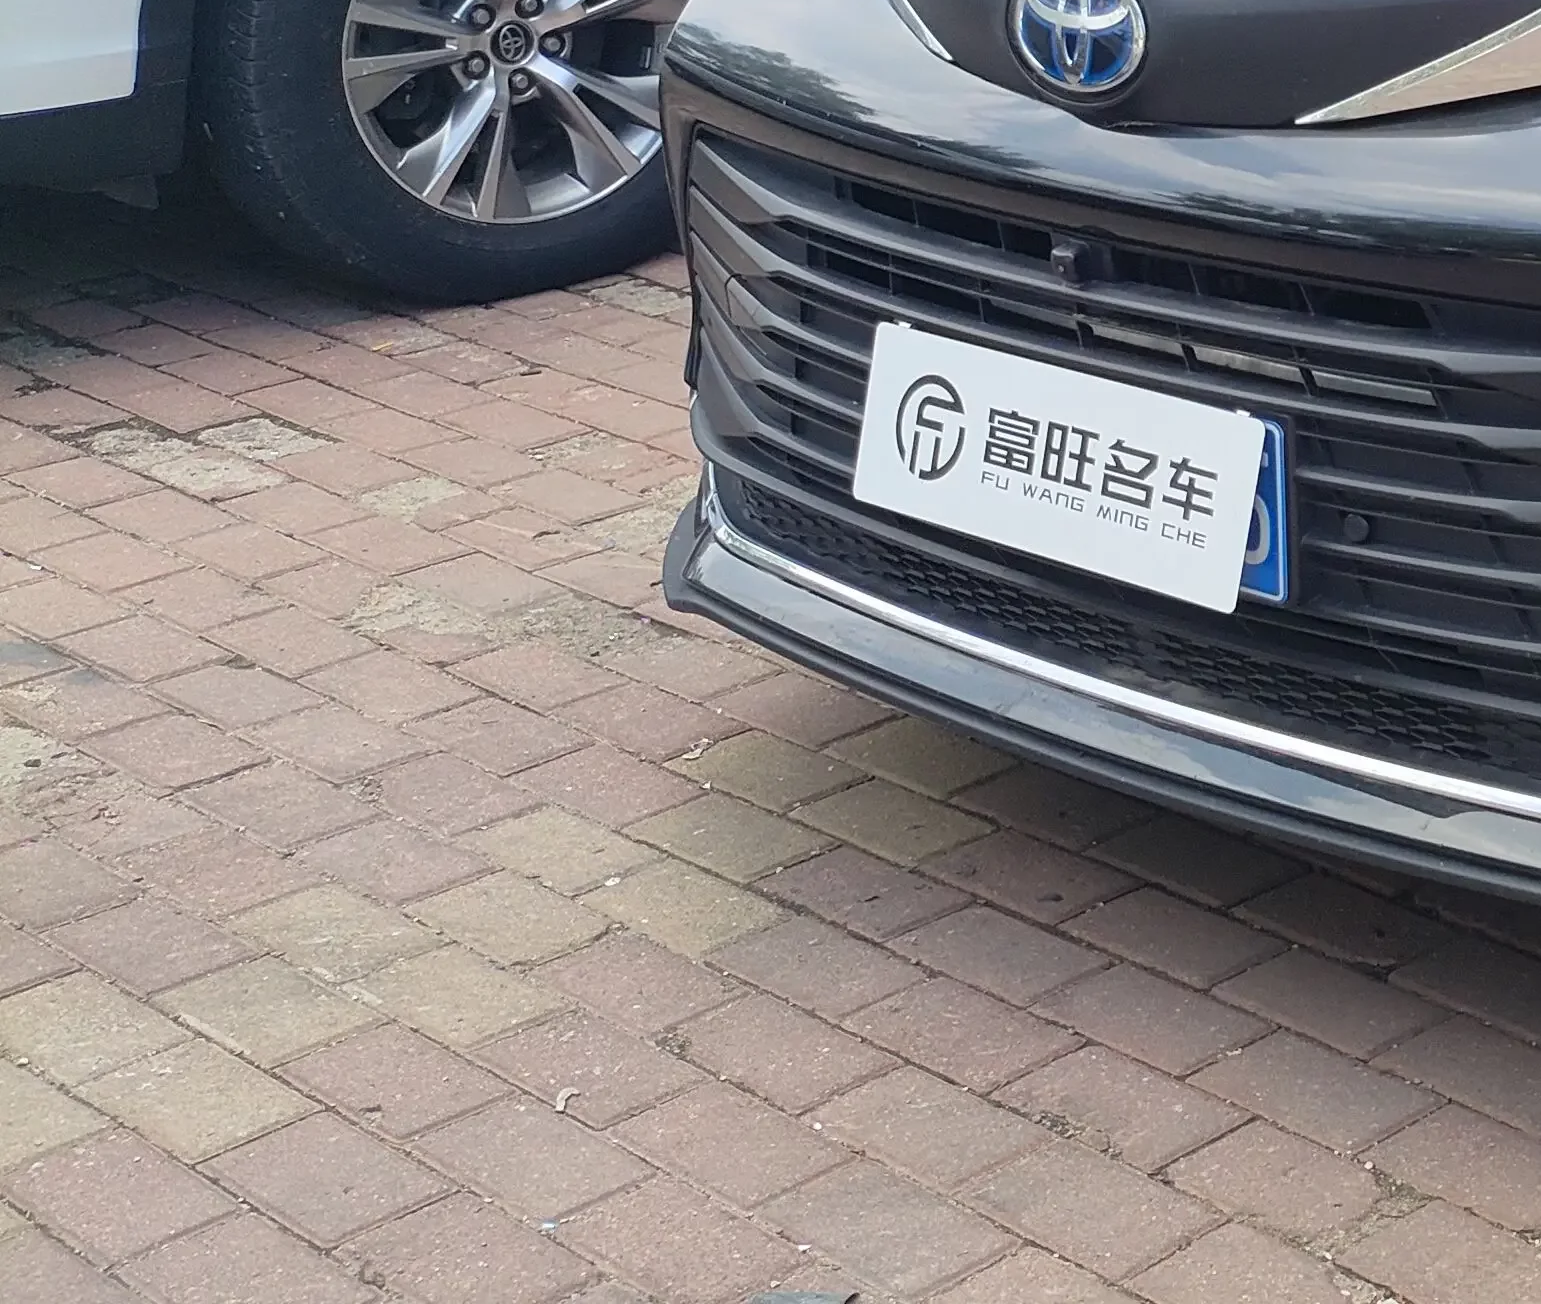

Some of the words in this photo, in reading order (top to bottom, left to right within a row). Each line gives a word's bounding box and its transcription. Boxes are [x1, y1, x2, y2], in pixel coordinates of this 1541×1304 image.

[981, 471, 1010, 491] FU
[1023, 483, 1085, 512] WANG
[1097, 504, 1149, 532] MING
[1161, 522, 1207, 549] CHE
[983, 408, 1219, 521] 富旺名车
